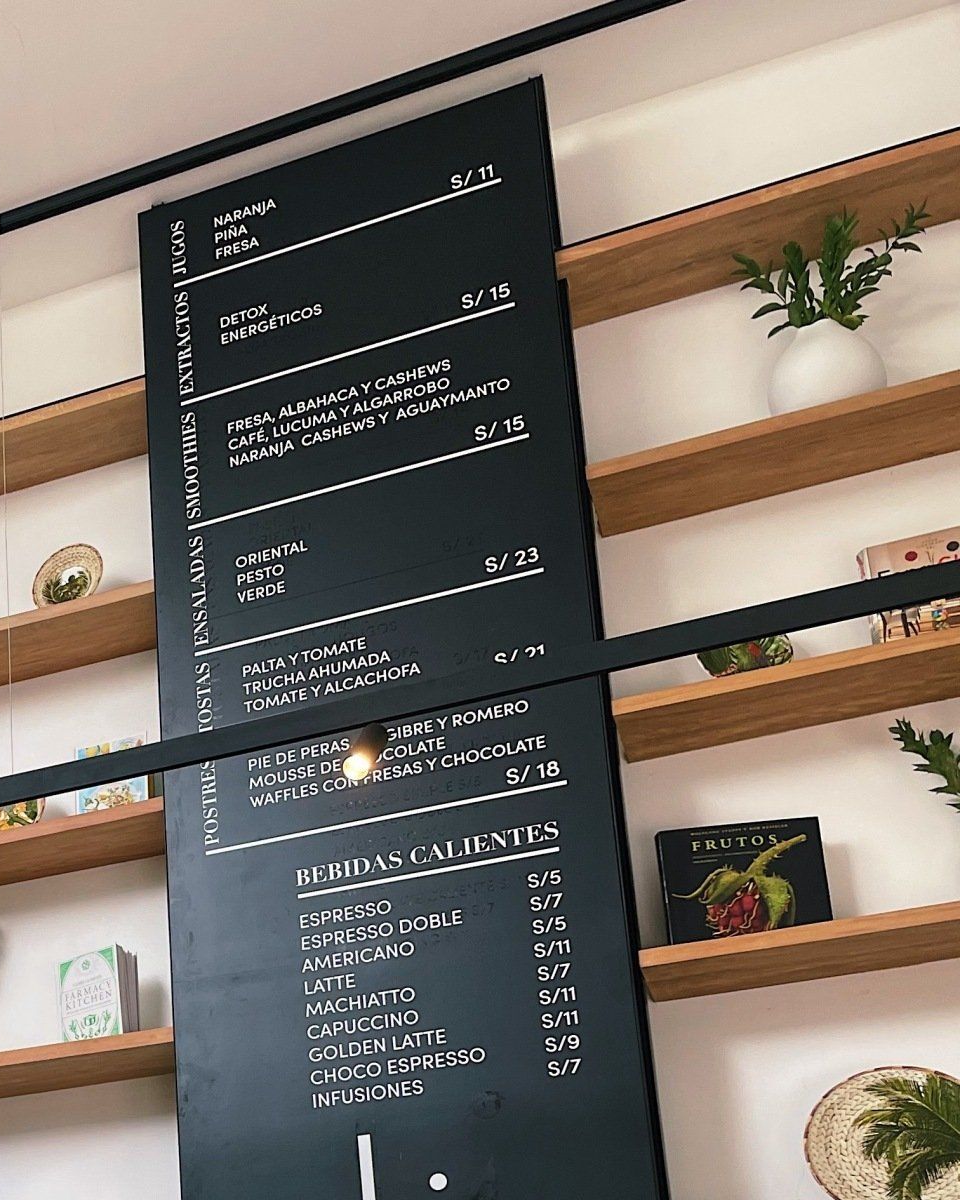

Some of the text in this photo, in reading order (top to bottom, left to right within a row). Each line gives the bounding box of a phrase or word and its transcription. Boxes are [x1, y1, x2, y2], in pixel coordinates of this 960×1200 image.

[451, 164, 494, 189] S/ 11
[214, 199, 276, 228] NARANJA
[215, 224, 248, 244] PIÑA
[171, 220, 187, 276] JUGOS
[216, 237, 259, 259] FRESA
[220, 303, 268, 328] DETOX
[462, 282, 510, 309] S/ 15
[174, 291, 194, 397] EXTRACTOS
[221, 304, 322, 345] ENERGÉTICOS
[227, 359, 451, 434] FRESA, ALBAHACA Y CASHEWS
[228, 377, 450, 450] CAFÉ, LUCUMA Y ALGARROBO
[229, 378, 510, 468] NARANJA CASHEWS Y AGUAYMANTO
[474, 415, 525, 441] S/ 15
[181, 411, 201, 519] SMOOTHIES
[235, 540, 308, 568] ORIENTAL
[237, 564, 284, 586] PESTO
[485, 547, 539, 573] S/ 23
[189, 535, 209, 648] ENSALADAS
[237, 581, 285, 603] VERDE
[242, 651, 391, 695] TRUCHA AHUMADA
[243, 637, 366, 677] PALTA Y TOMATE
[244, 663, 421, 713] TOMATE Y ALCACHOFA
[248, 755, 271, 771] PIE
[276, 750, 296, 765] DE
[387, 720, 434, 741] GIBRE
[436, 716, 448, 730] Y
[452, 700, 529, 727] ROMERO
[249, 764, 316, 790] MOUSSE
[320, 759, 341, 774] DE
[250, 783, 318, 807] WAFFLES
[425, 757, 437, 771] Y
[441, 735, 546, 768] CHOCOLATE
[506, 761, 560, 784] S/ 18
[296, 821, 559, 886] BEBIDAS CALIENTES
[692, 834, 777, 852] FRUTOS
[300, 870, 561, 929] ESPRESSO S/5
[301, 922, 393, 950] ESPRESSO
[399, 910, 463, 934] DOBLE
[530, 893, 563, 911] S/7
[302, 916, 566, 973] AMERICANO S/5
[304, 939, 571, 995] LATTE S/11
[64, 979, 113, 1002] FARMACY
[65, 989, 113, 1011] KITCHEN
[306, 963, 570, 1017] MACHIATTO S/7
[307, 986, 576, 1039] CAPUCCINO S/11
[309, 1010, 578, 1062] GOLDEN LATTE S/11
[311, 1035, 580, 1085] CHOCO ESPRESSO S/9
[312, 1058, 581, 1108] INFUSIONES S/7
